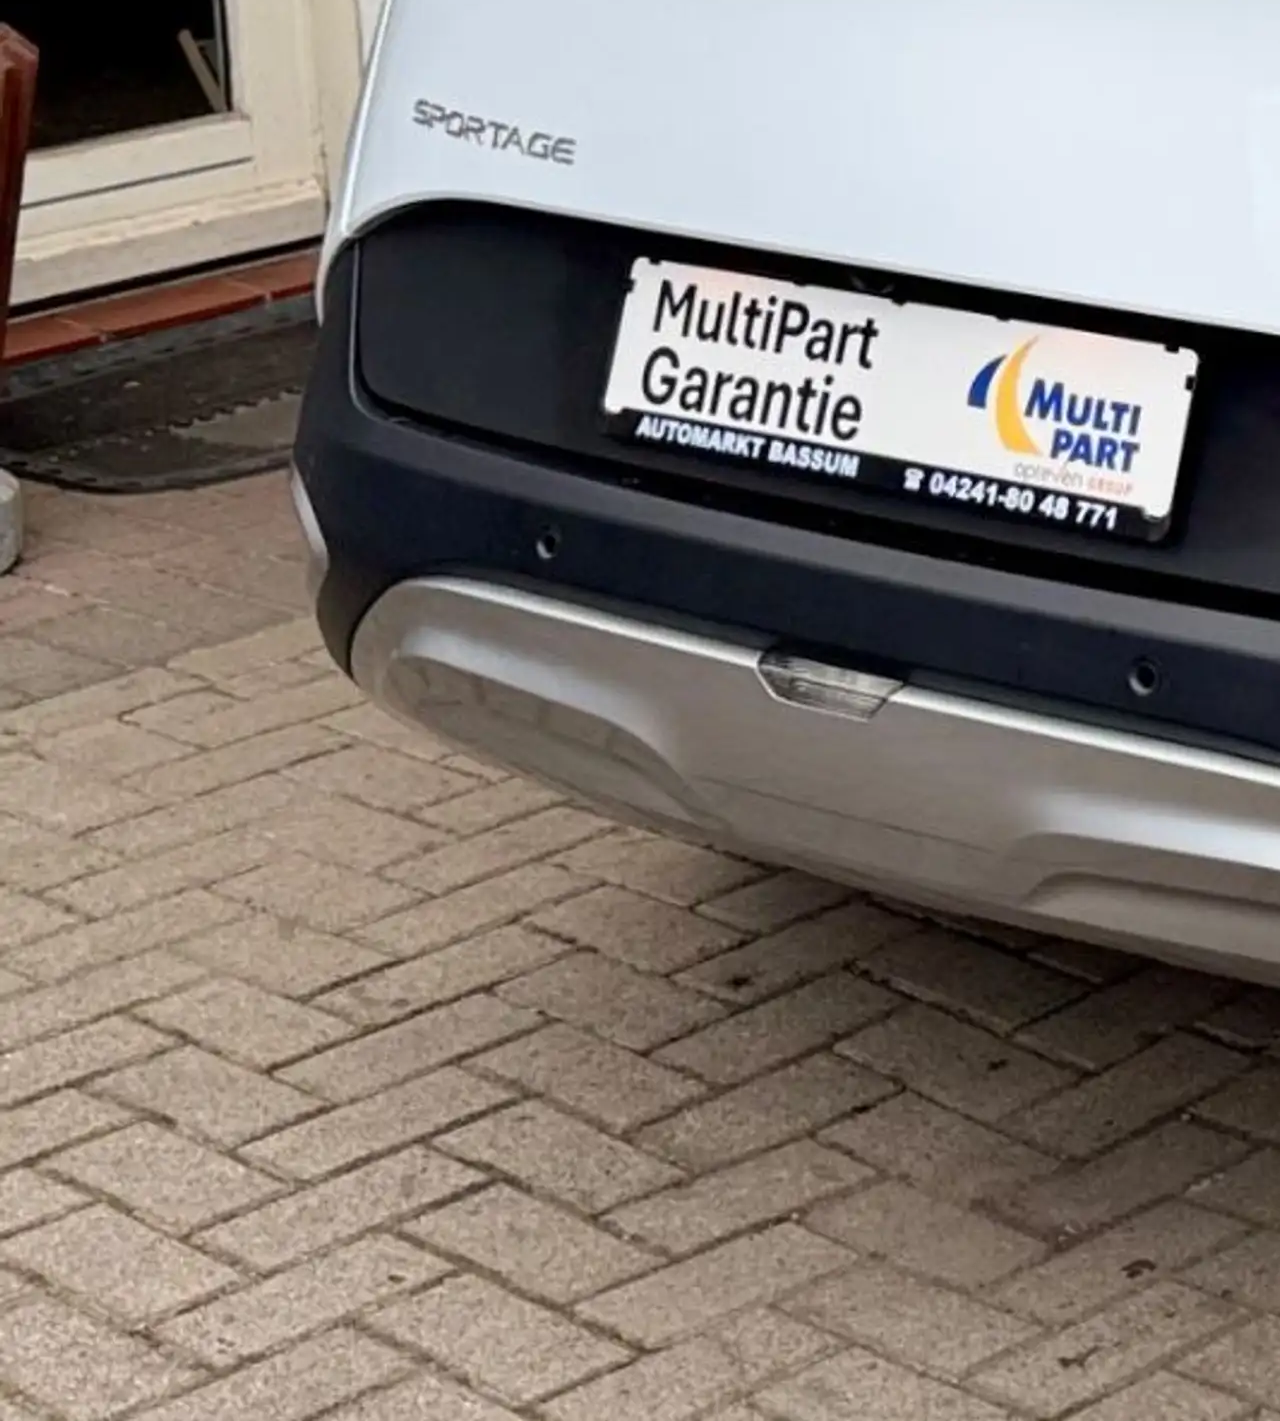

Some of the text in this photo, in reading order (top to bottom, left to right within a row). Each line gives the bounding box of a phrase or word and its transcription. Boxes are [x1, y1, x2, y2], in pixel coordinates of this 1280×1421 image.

[412, 98, 577, 165] SPORTAGE
[652, 278, 880, 370] MultiPart
[640, 346, 863, 441] Garantie
[1024, 378, 1142, 437] MULTI
[635, 415, 861, 478] AUTOMARKT BASSUM
[1050, 427, 1141, 473] PART
[928, 471, 1118, 531] 04241-80 48 771
